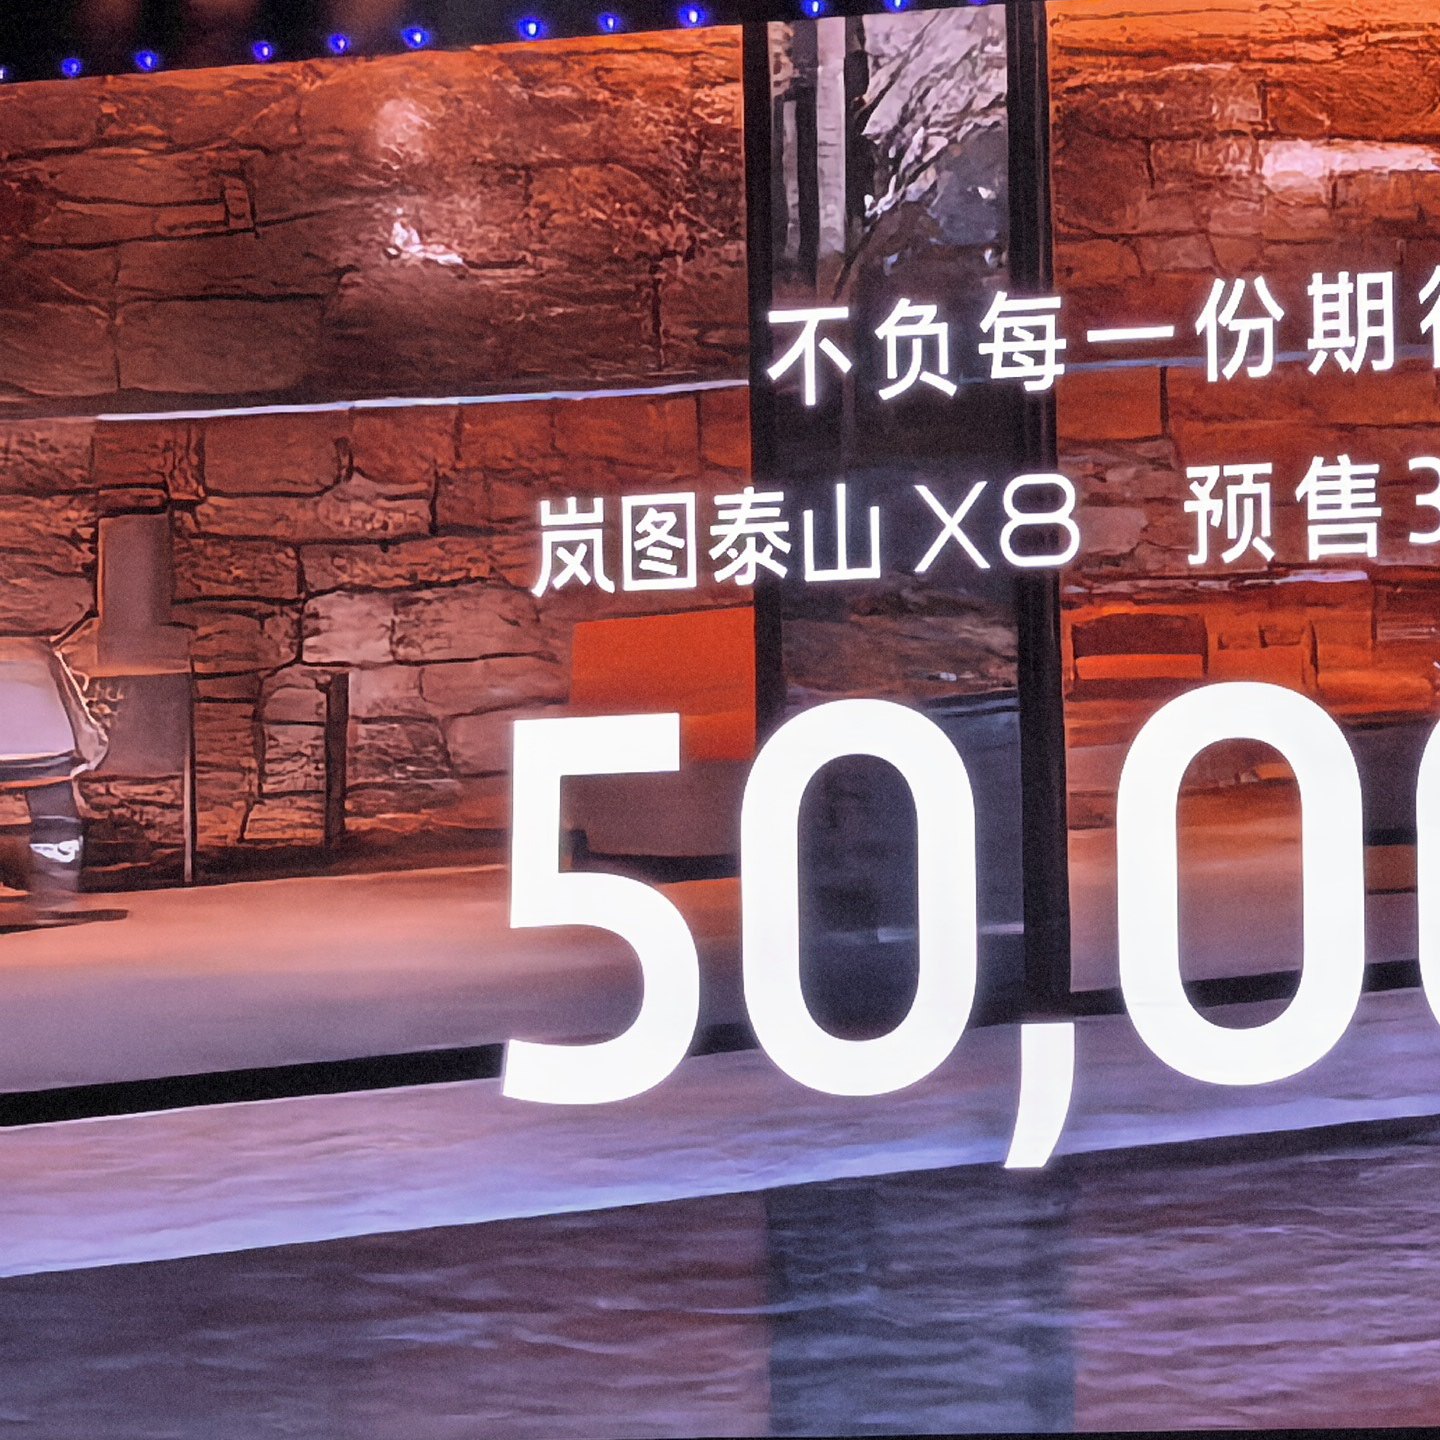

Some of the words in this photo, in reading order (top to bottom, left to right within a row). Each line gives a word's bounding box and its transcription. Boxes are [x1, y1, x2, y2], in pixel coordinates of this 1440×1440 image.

[530, 482, 882, 598] 岚图泰山
[913, 472, 1081, 573] X8
